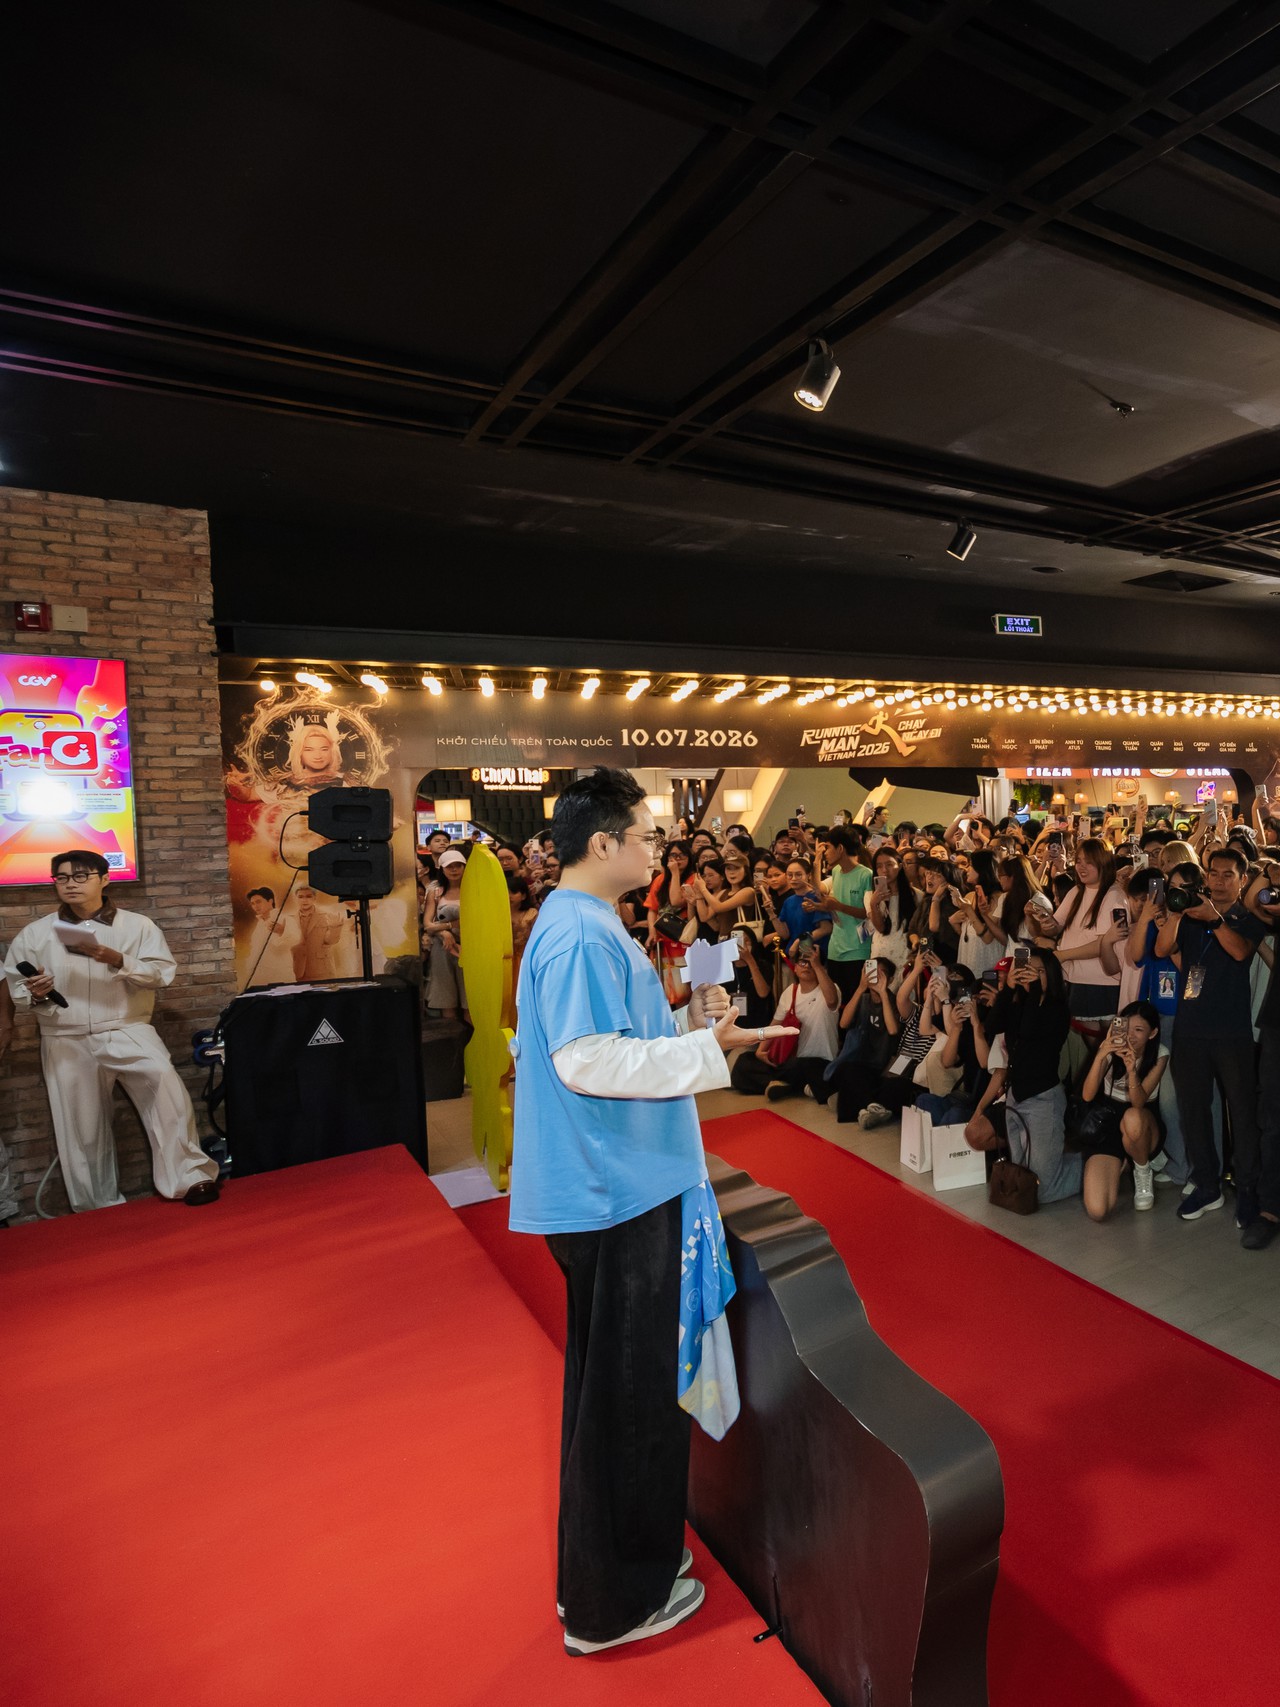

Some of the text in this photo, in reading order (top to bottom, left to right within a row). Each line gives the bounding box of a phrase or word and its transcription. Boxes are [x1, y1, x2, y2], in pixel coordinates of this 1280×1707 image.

[1004, 624, 1034, 633] LỐI THOÁT
[1006, 617, 1031, 626] EXIT
[17, 674, 51, 687] CGV
[898, 718, 926, 732] CHẠY
[436, 735, 613, 747] KHỞI CHIẾU TRÊN TOÀN QUỐC
[621, 728, 758, 747] 10.07.2026
[800, 724, 862, 746] RUNNING
[819, 735, 860, 753] MAN
[818, 742, 890, 762] VIETNAM 2026
[517, 767, 543, 784] Thai
[949, 1149, 971, 1159] FOREST
